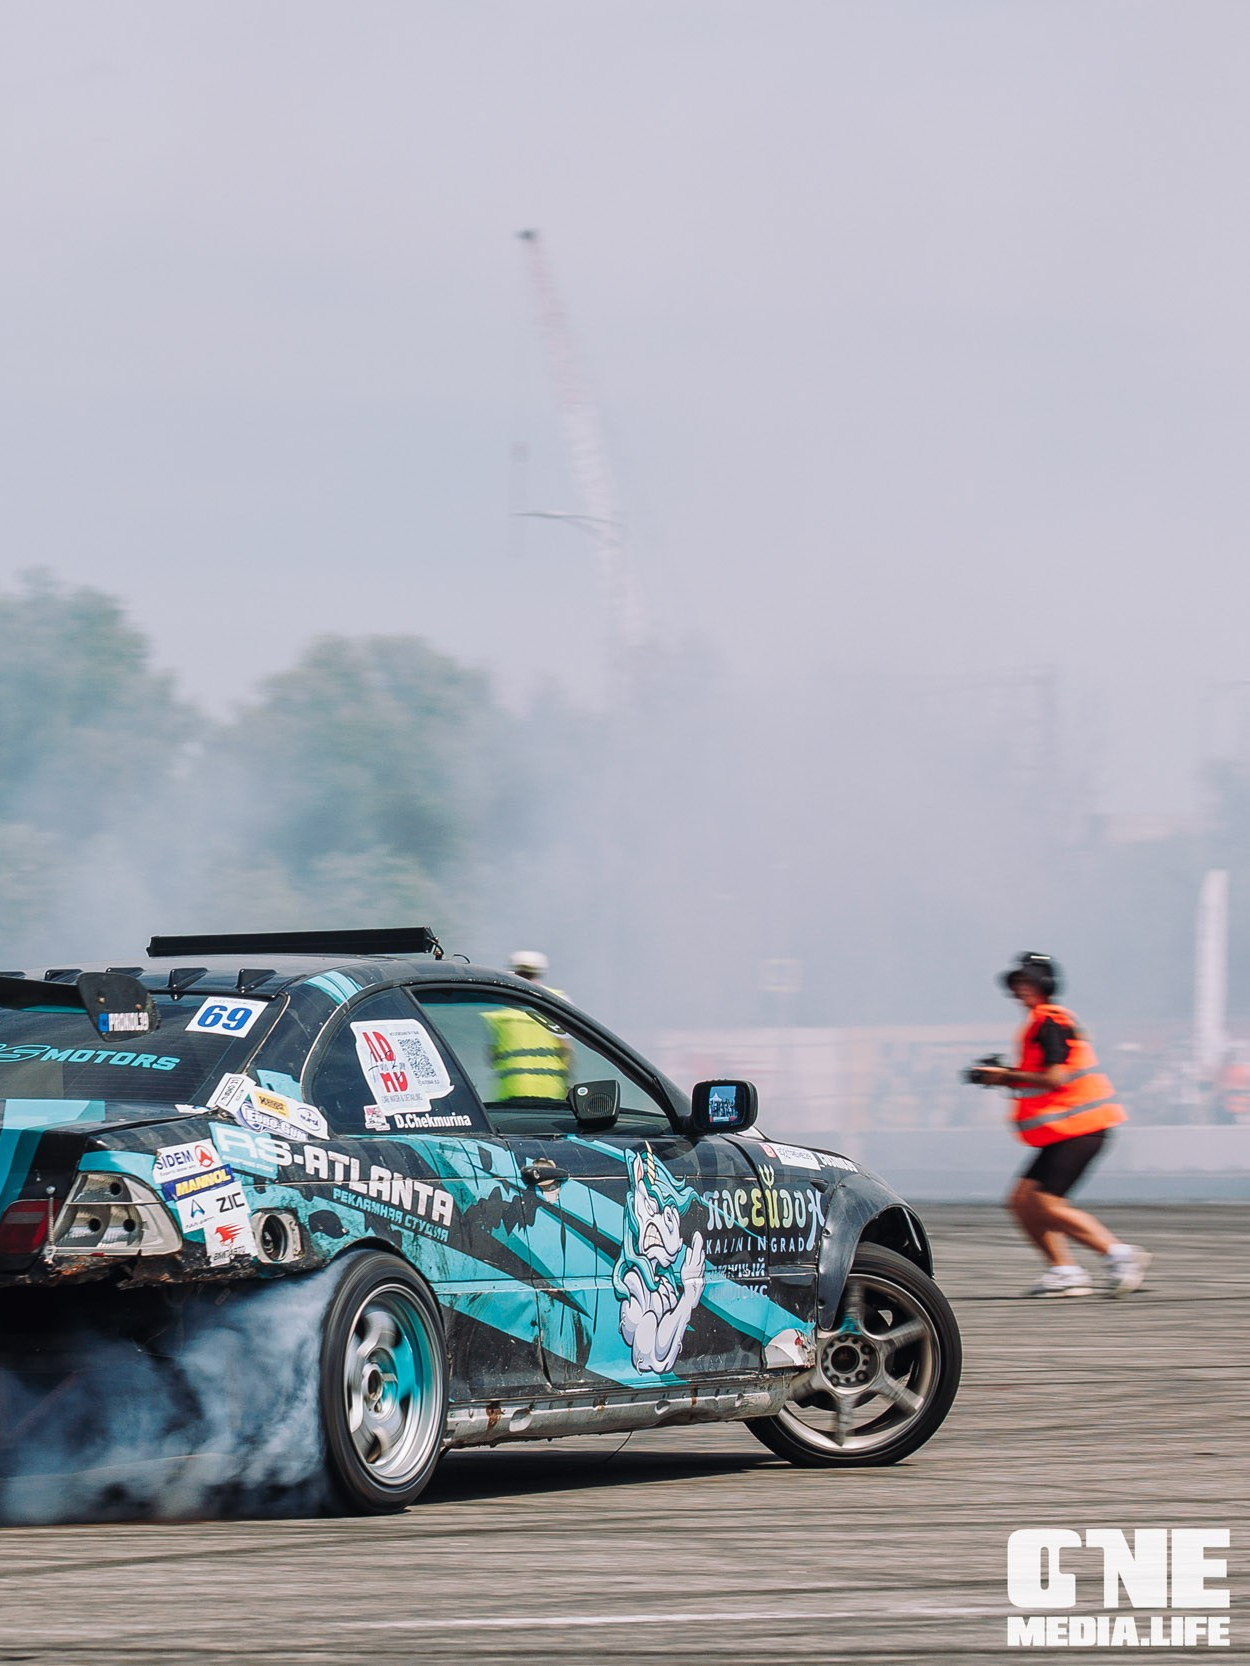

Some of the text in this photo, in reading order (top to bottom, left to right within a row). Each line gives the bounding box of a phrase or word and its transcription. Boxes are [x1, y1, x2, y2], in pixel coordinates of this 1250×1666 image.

[197, 1005, 253, 1031] 69
[42, 1049, 182, 1072] MOTORS
[393, 1112, 472, 1129] D.Chekmurina
[156, 1150, 194, 1170] SIDEM
[175, 1169, 231, 1197] MANNOL
[216, 1192, 245, 1213] ZIC
[333, 1187, 450, 1243] РЕКЛАМНАЯ СТУДИЯ
[706, 1235, 806, 1255] KALININGRAD
